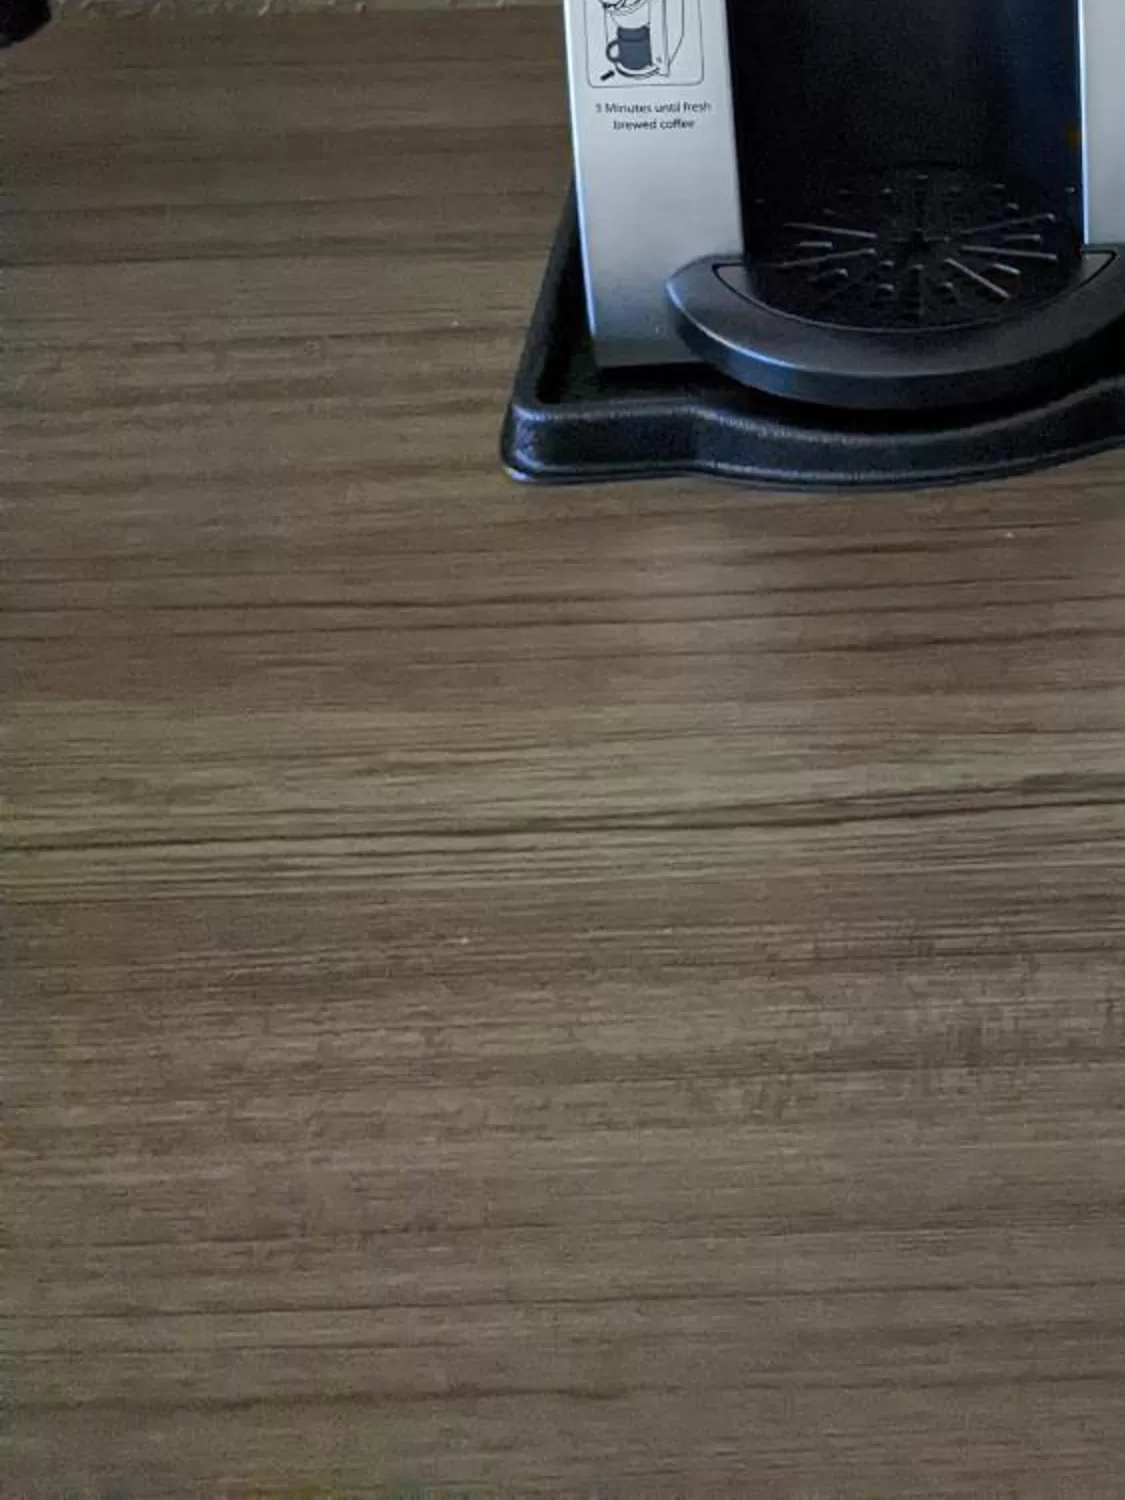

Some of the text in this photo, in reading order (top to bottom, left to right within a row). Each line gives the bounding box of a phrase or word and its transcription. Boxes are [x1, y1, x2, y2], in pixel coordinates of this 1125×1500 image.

[604, 102, 651, 113] Minutes
[654, 101, 681, 113] until
[683, 100, 712, 113] fresh
[612, 117, 696, 130] brewed coffee
